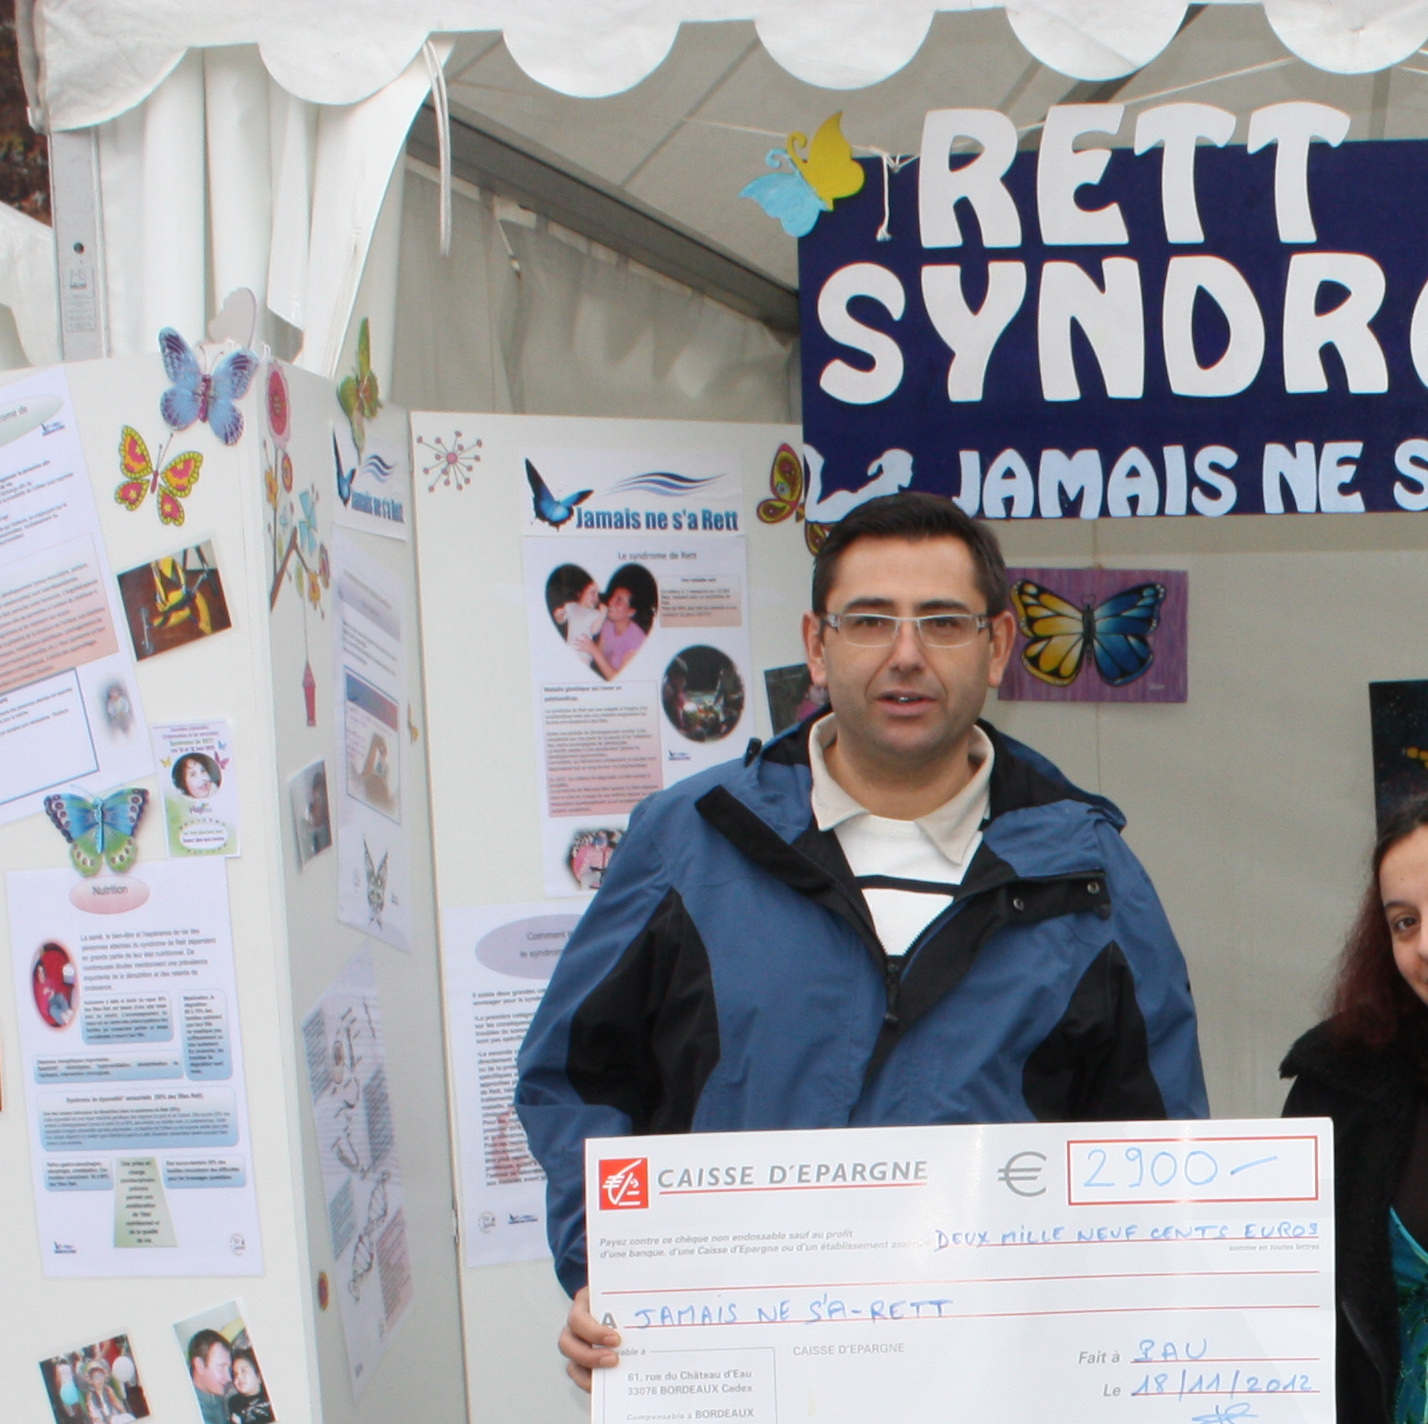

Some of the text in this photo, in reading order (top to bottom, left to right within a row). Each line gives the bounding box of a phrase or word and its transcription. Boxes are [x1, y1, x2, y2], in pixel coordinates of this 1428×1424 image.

[918, 102, 1351, 250] RETT
[952, 444, 1239, 520] JAMAIS
[1263, 442, 1364, 513] NE
[576, 506, 739, 531] Jamais ne s'a Rett
[657, 1161, 928, 1188] CAISSE D'EPARGNE
[997, 1152, 1047, 1197] €
[934, 1228, 989, 1252] DEUX
[1077, 1225, 1137, 1241] NEUF
[602, 1313, 617, 1329] A
[758, 1301, 790, 1322] NE
[793, 1344, 905, 1355] CAISSE D'EPARGNE
[1079, 1350, 1120, 1364] Fait à
[665, 1372, 677, 1380] du
[680, 1370, 721, 1380] Château
[1131, 1369, 1312, 1401] 18/11/2012
[660, 1384, 718, 1395] BORDEAUX
[722, 1383, 753, 1393] Cedex
[1103, 1384, 1121, 1396] Le
[695, 1408, 754, 1418] BORDEAUX
